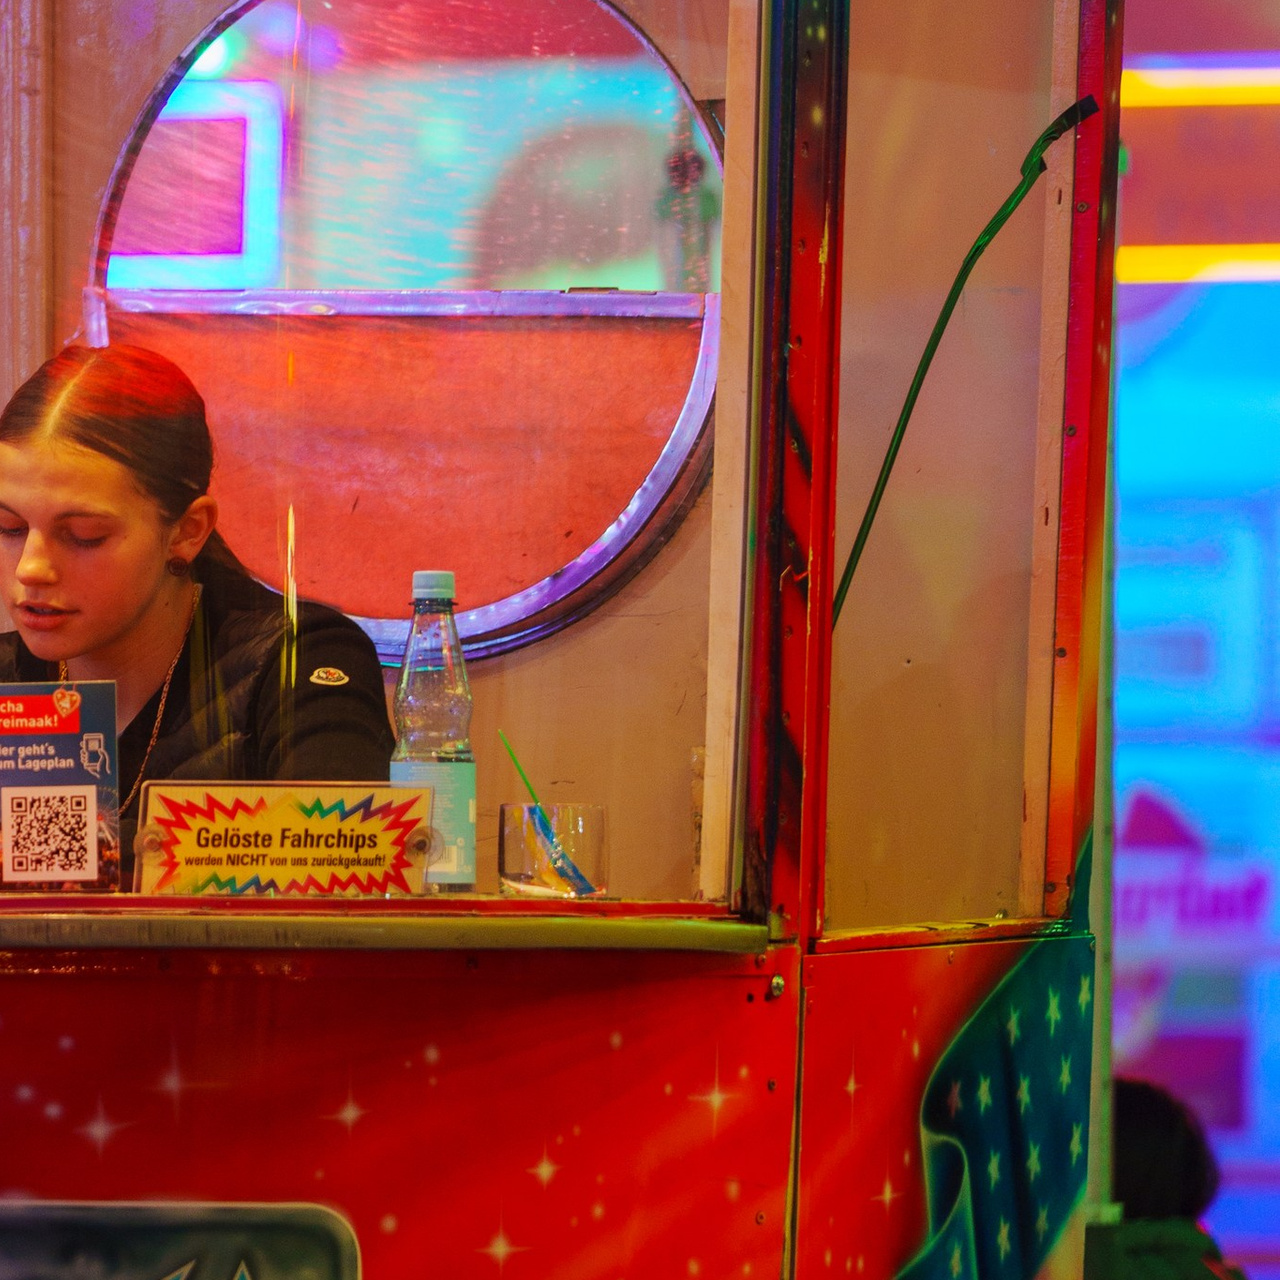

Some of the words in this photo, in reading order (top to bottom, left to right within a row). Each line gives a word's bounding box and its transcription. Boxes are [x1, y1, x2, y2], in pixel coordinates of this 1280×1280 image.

[18, 742, 56, 759] geht's
[17, 756, 75, 772] Lageplan
[196, 826, 273, 849] Gelöste
[279, 827, 379, 853] Fahrchips
[184, 854, 223, 867] werden
[226, 854, 268, 867] NICHT
[270, 856, 287, 867] von
[291, 856, 308, 867] uns
[311, 853, 387, 869] zurückgekauft!
